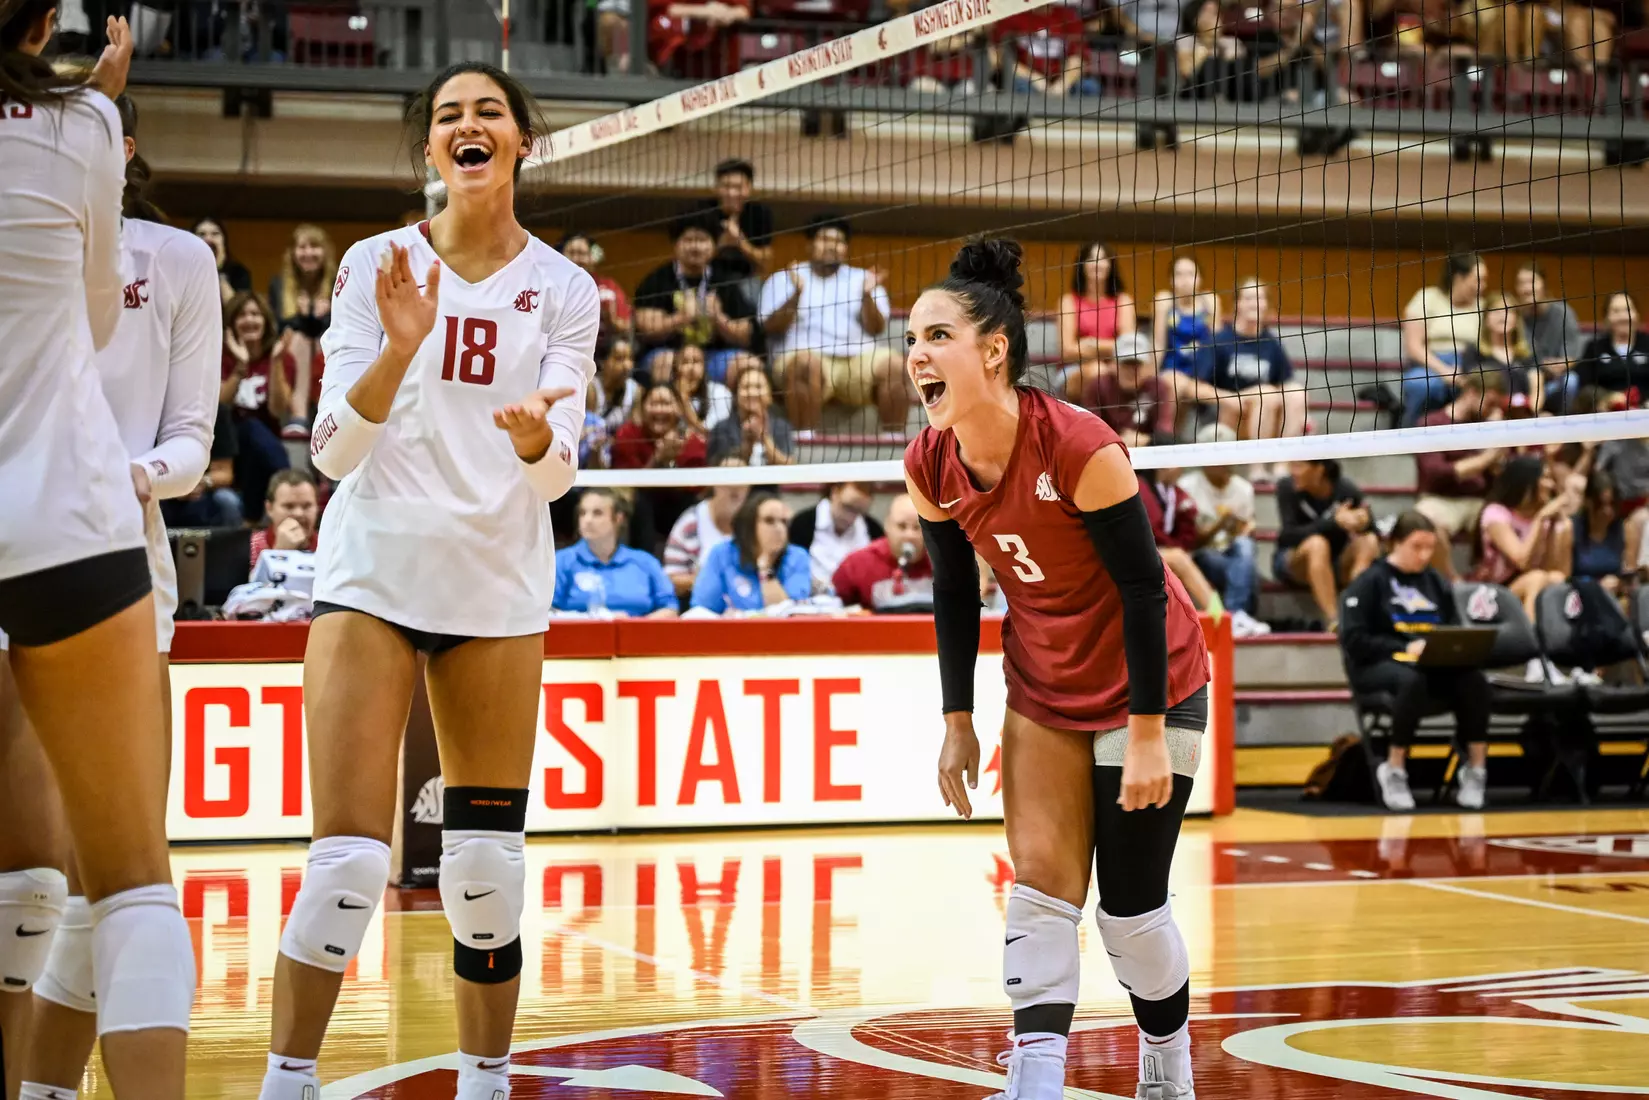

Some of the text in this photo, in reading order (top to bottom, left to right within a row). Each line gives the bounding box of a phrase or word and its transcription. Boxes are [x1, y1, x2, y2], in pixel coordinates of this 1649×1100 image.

[913, 0, 991, 38] WASHINGTON STATE
[788, 45, 832, 79] WASHINGTON
[441, 315, 498, 386] 18
[992, 534, 1046, 583] 3
[541, 678, 863, 809] STATE
